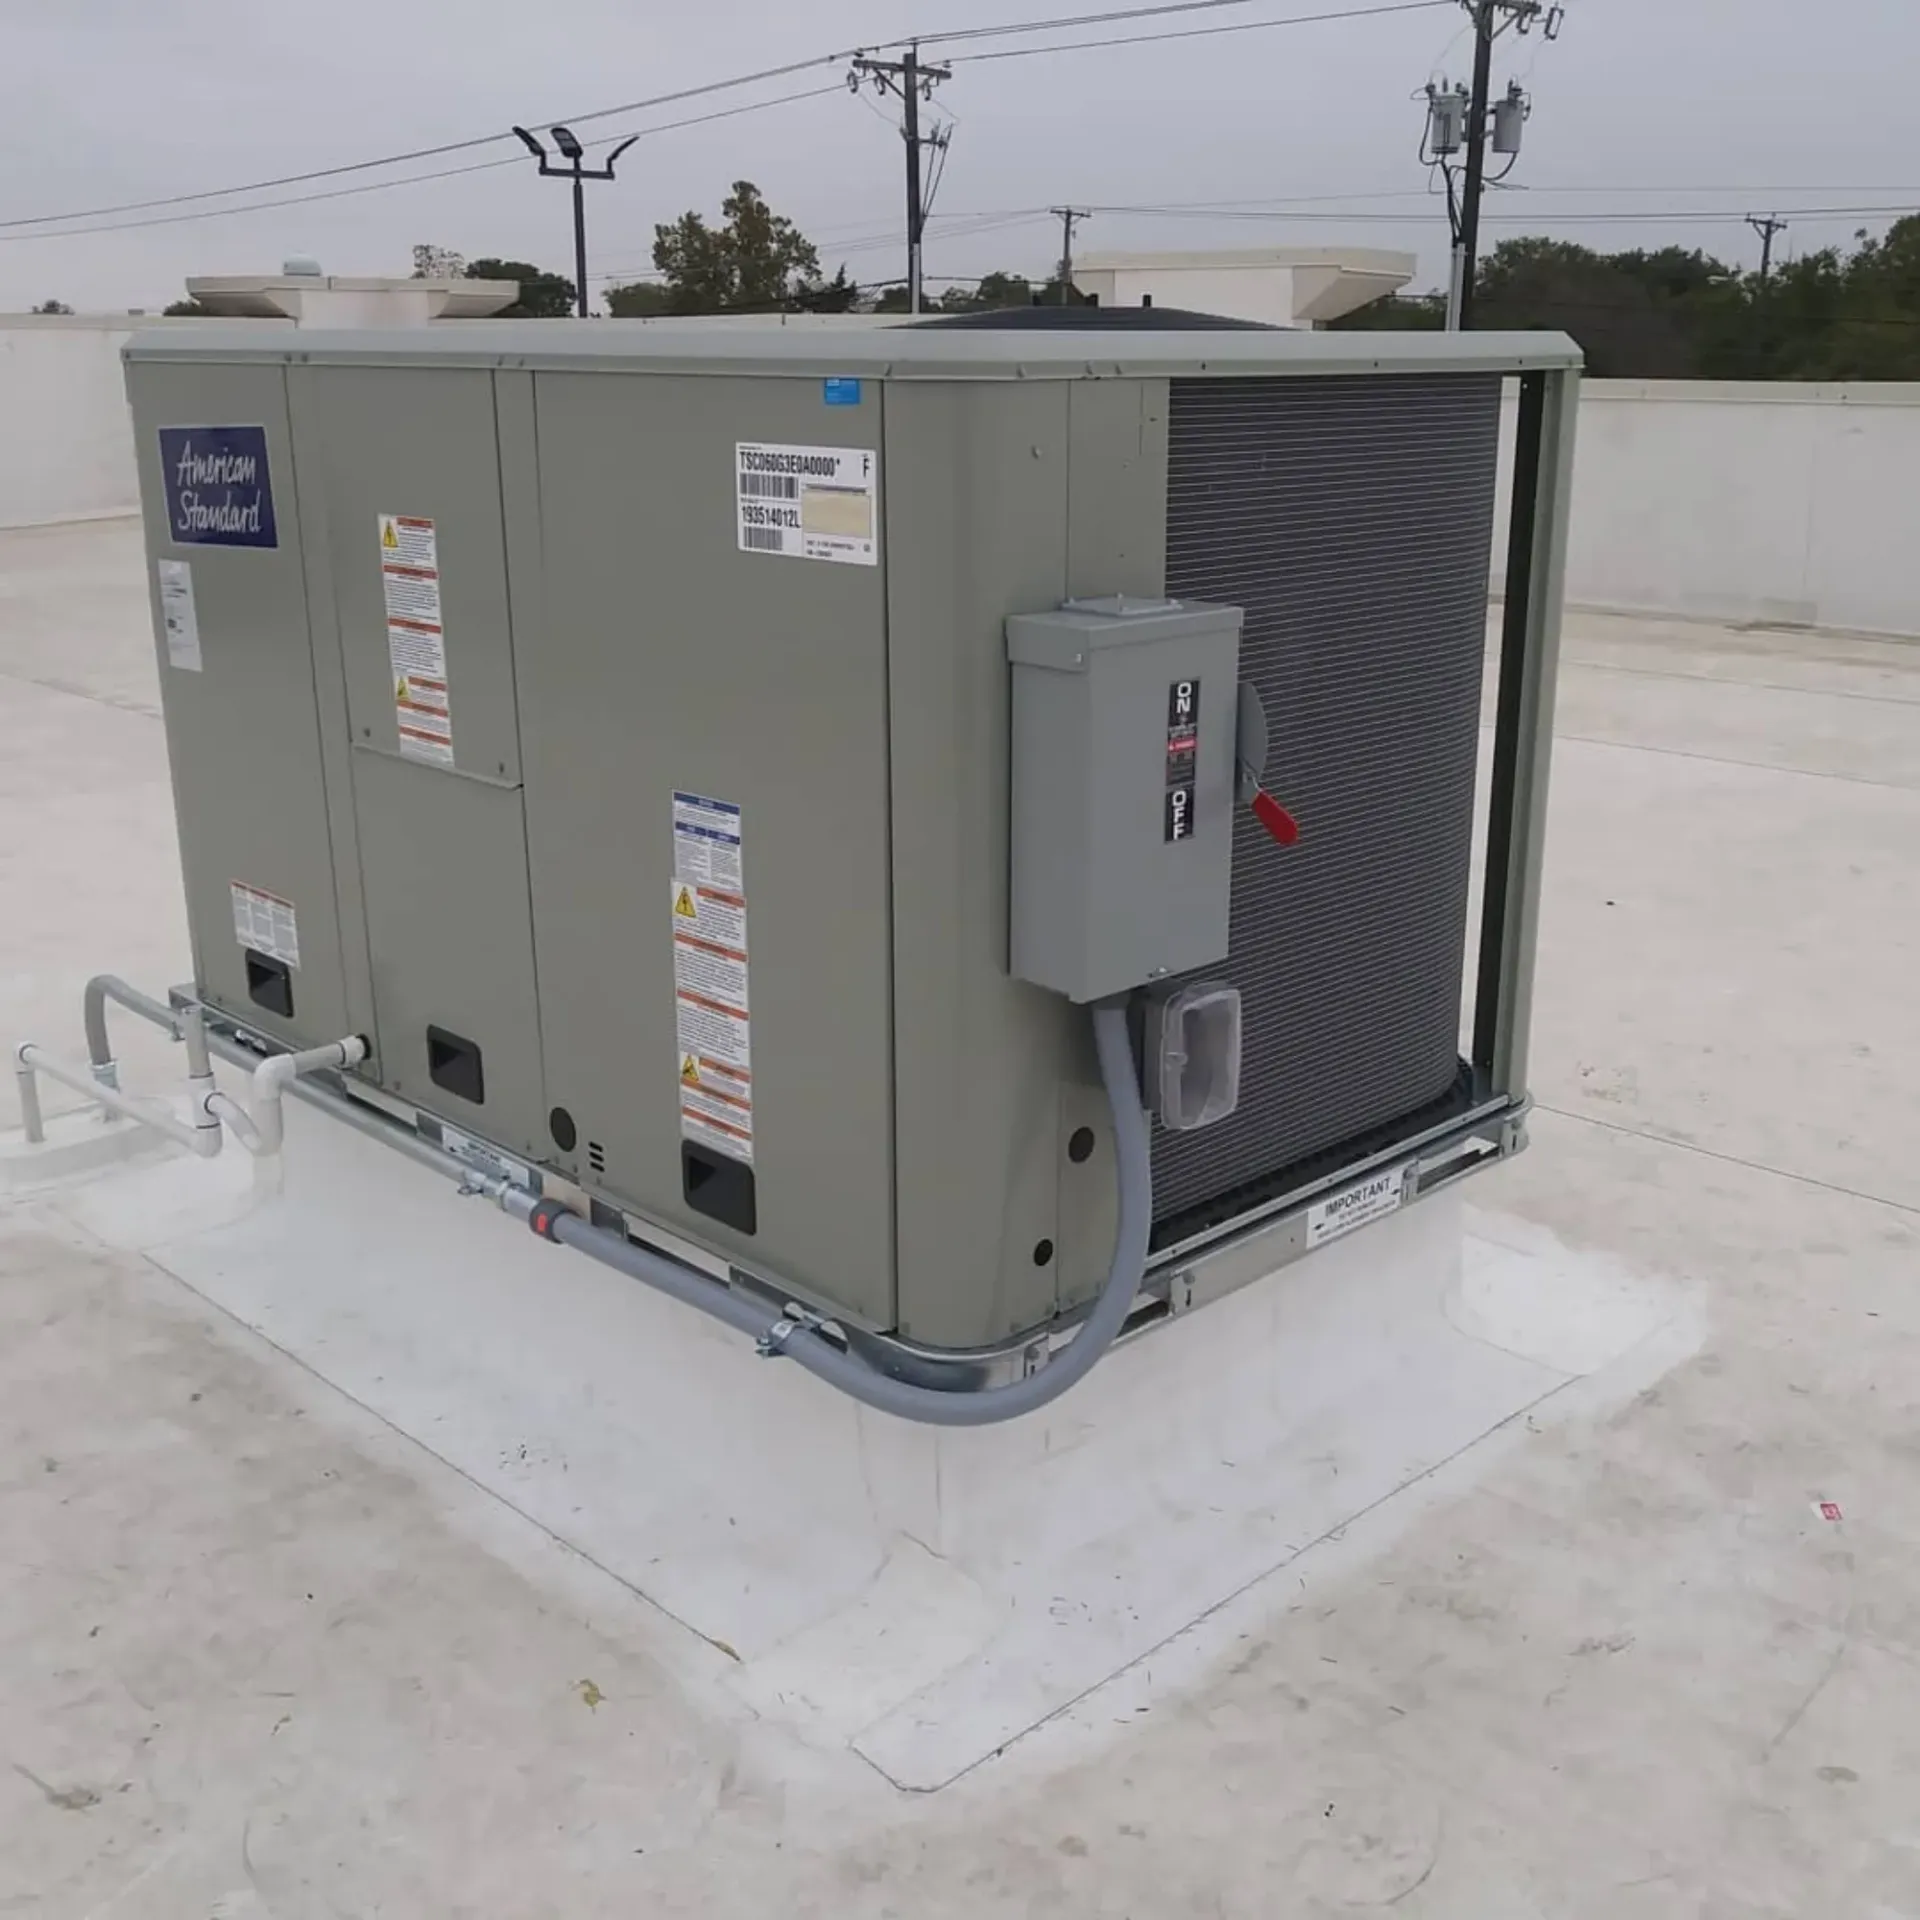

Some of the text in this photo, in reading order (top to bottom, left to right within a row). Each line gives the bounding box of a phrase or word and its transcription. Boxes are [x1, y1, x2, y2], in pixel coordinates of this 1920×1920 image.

[177, 440, 256, 486] American
[178, 490, 262, 533] Standard
[1176, 682, 1192, 713] ON
[1172, 790, 1187, 841] OFF
[1325, 1176, 1391, 1217] IMPORTANT
